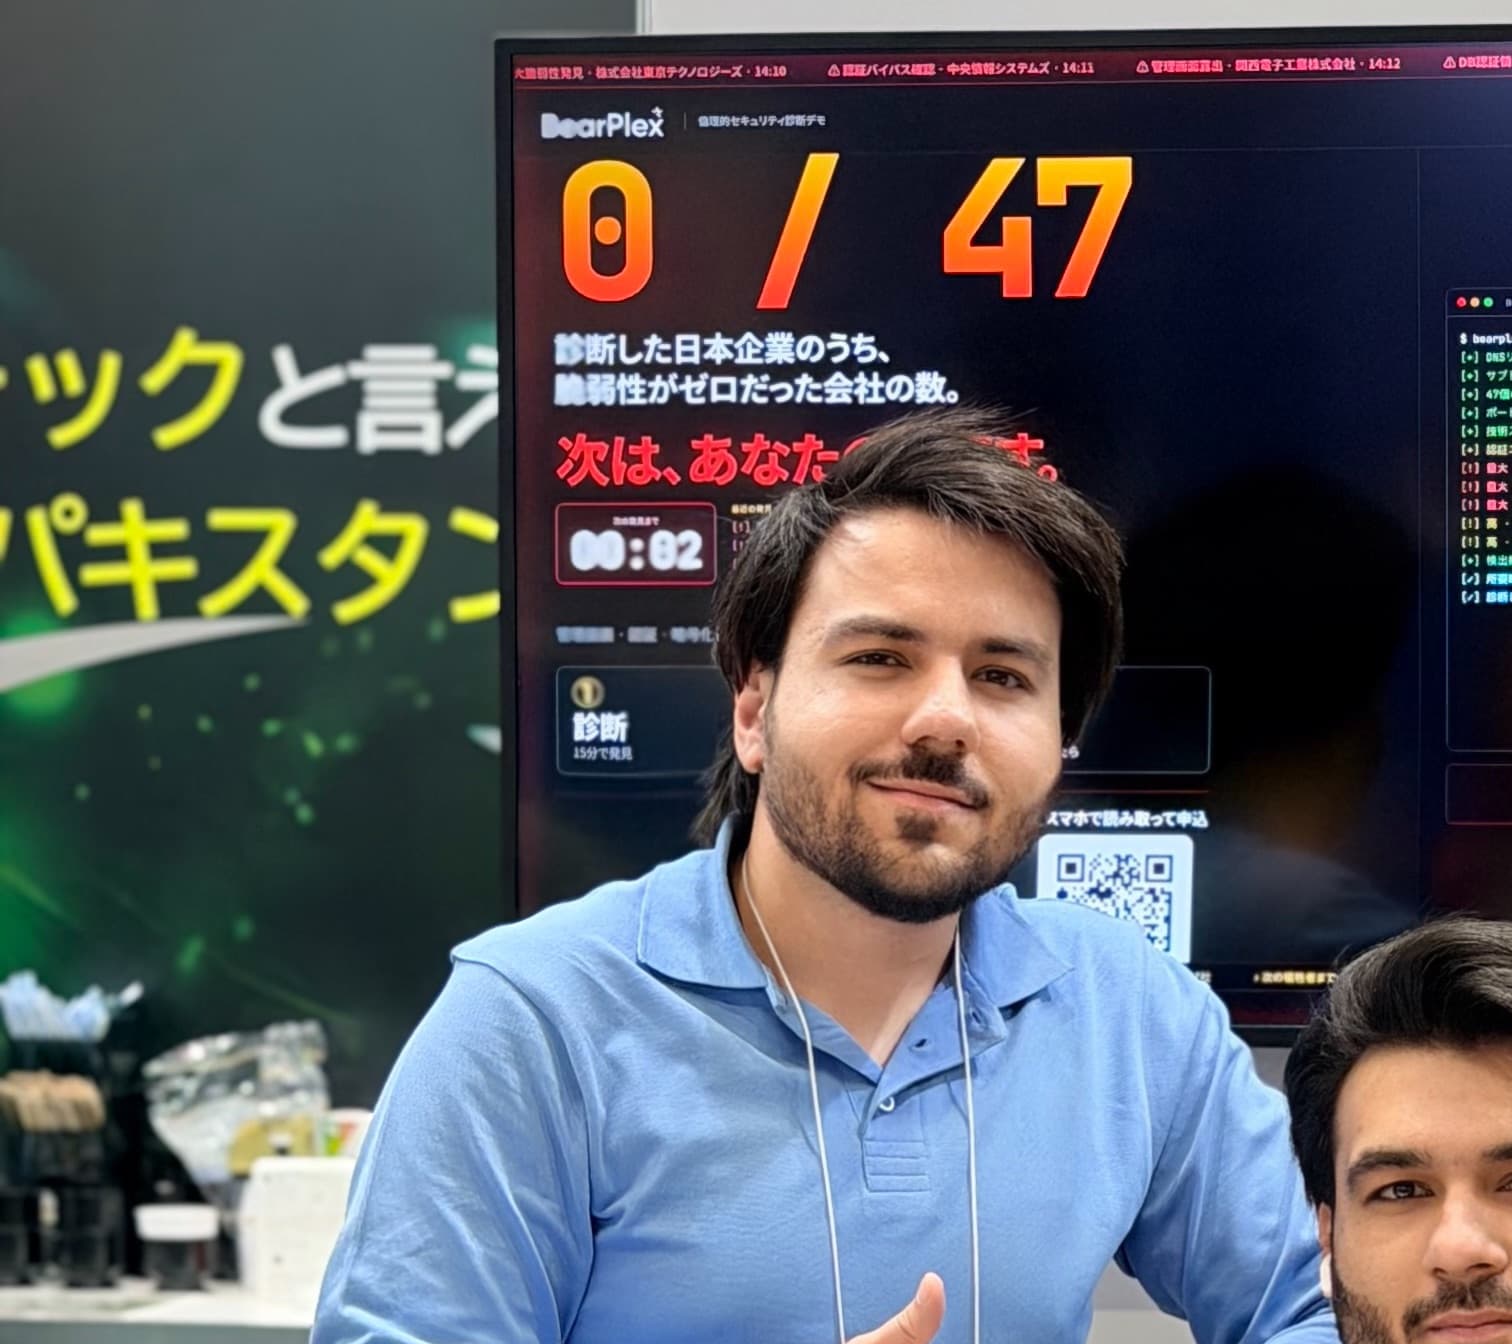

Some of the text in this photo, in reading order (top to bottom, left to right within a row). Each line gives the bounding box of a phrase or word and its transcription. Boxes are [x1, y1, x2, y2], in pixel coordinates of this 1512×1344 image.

[754, 65, 787, 77] 14:10
[1062, 61, 1095, 74] 14:11
[1368, 58, 1401, 70] 14:12
[541, 112, 664, 138] BearPlex
[563, 159, 653, 301] 0
[943, 156, 1134, 297] 47
[553, 332, 890, 367] 診断した日本企業のうち、
[553, 371, 960, 406] 脆弱性がゼロだった会社の数。
[572, 711, 628, 743] 診断
